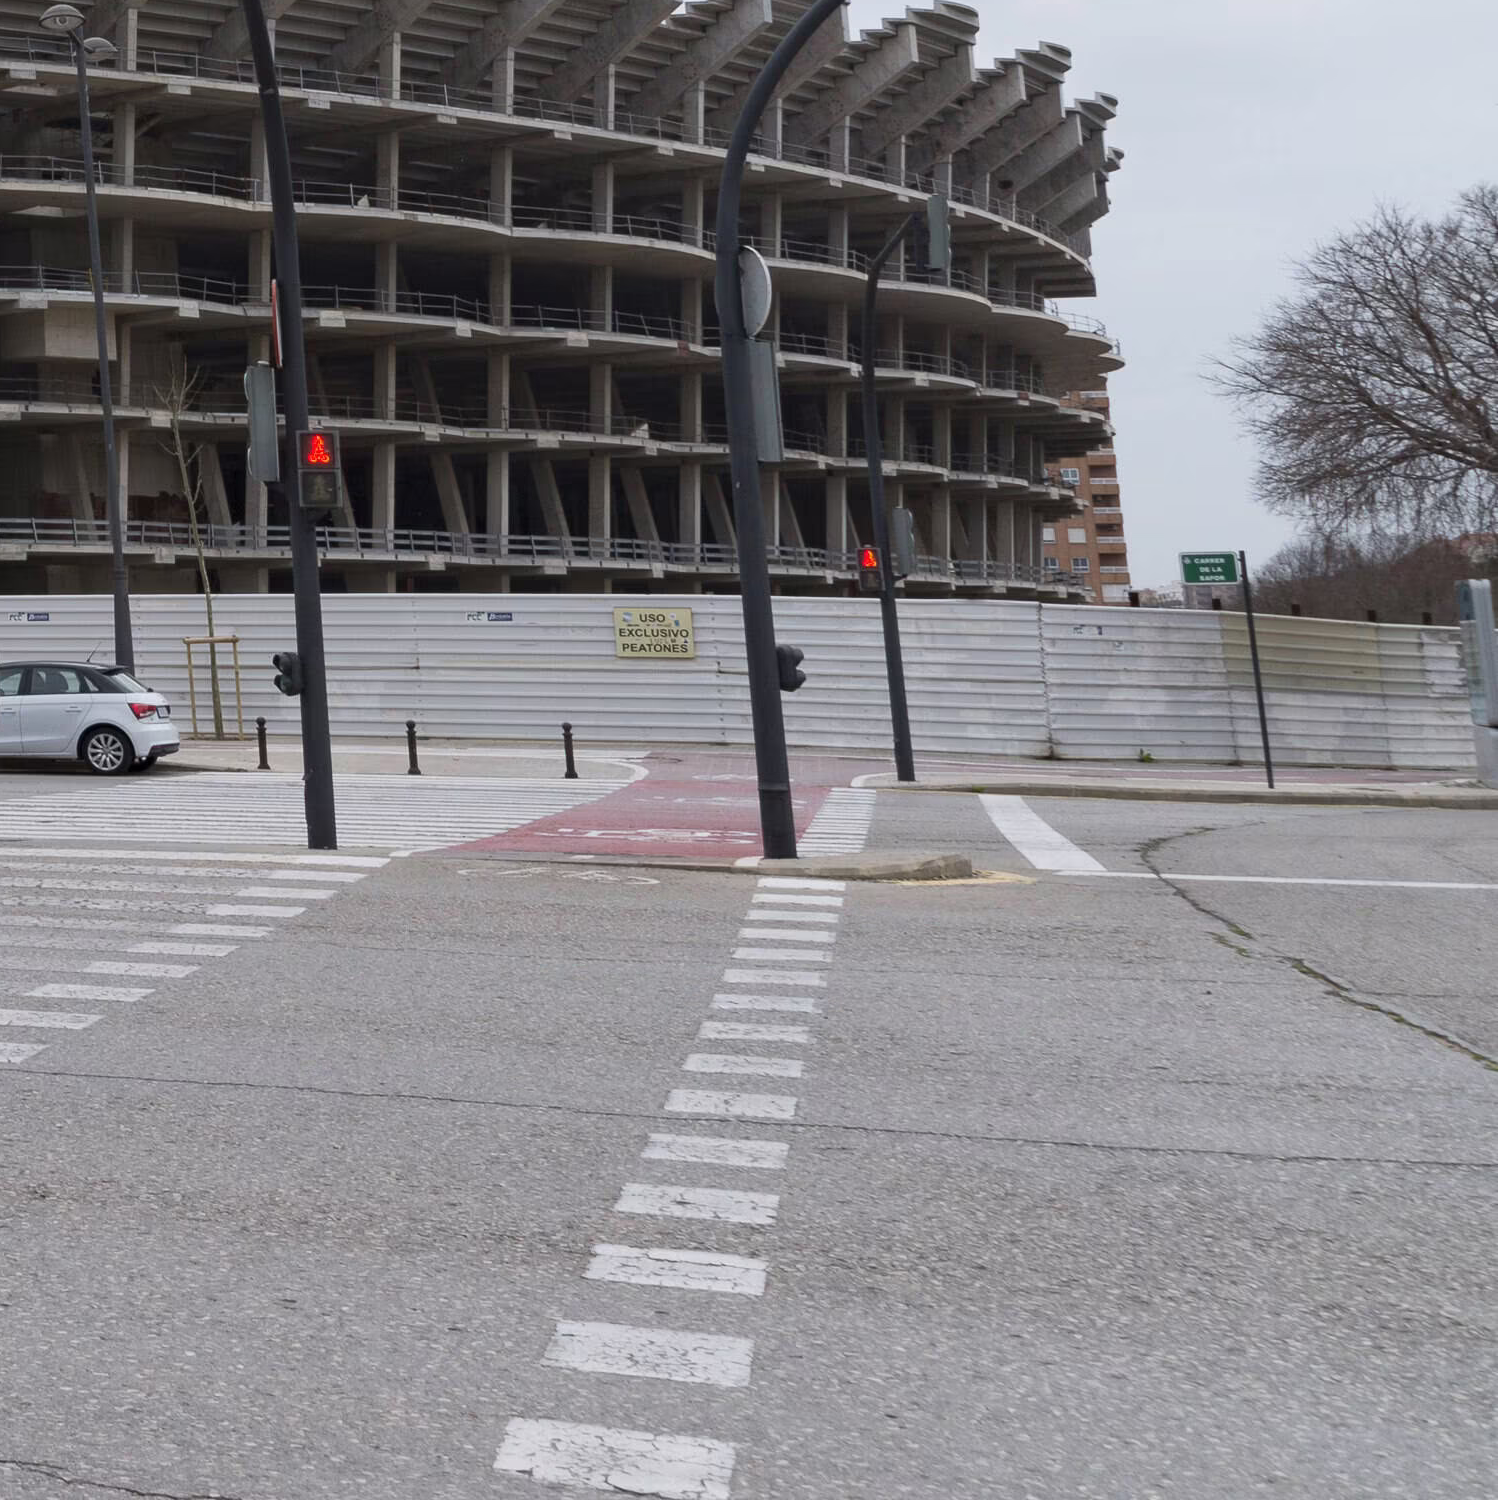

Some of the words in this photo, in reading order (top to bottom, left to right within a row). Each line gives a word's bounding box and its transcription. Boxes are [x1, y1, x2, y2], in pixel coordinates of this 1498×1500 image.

[639, 613, 666, 623] USO
[618, 628, 689, 638] EXCLUSIVO
[622, 643, 688, 653] PEATONES
